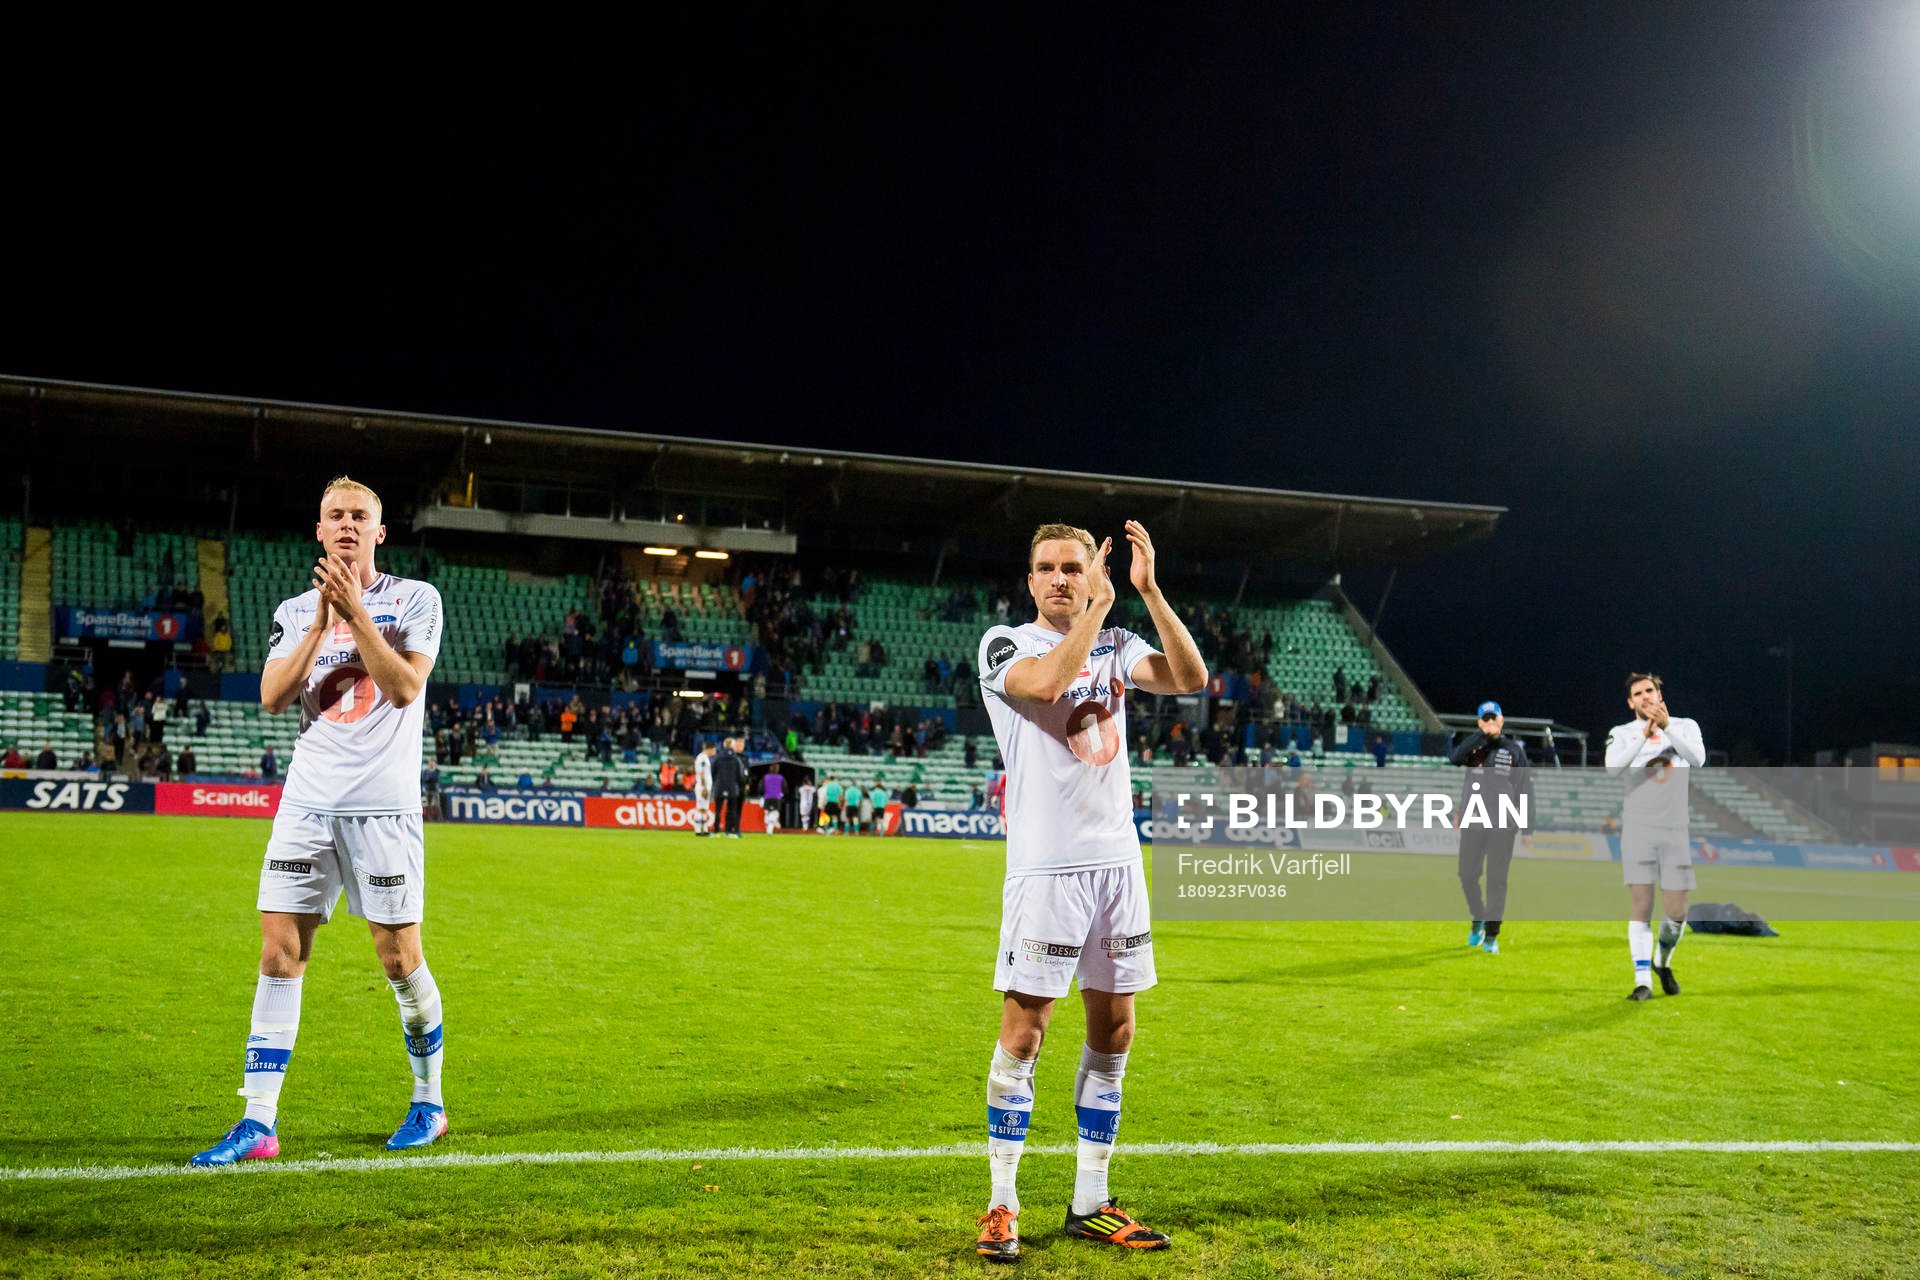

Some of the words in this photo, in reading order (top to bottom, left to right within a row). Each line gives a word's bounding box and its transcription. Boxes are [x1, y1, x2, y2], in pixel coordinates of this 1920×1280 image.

[336, 677, 355, 713] 1
[1081, 713, 1103, 754] 1
[26, 781, 130, 811] SATS
[193, 789, 270, 808] Scandic
[451, 795, 583, 822] macron
[615, 800, 715, 826] altibo
[905, 812, 1007, 835] macro
[271, 861, 309, 873] DESIGN
[370, 876, 404, 886] DESIGN
[1104, 939, 1126, 949] NOR
